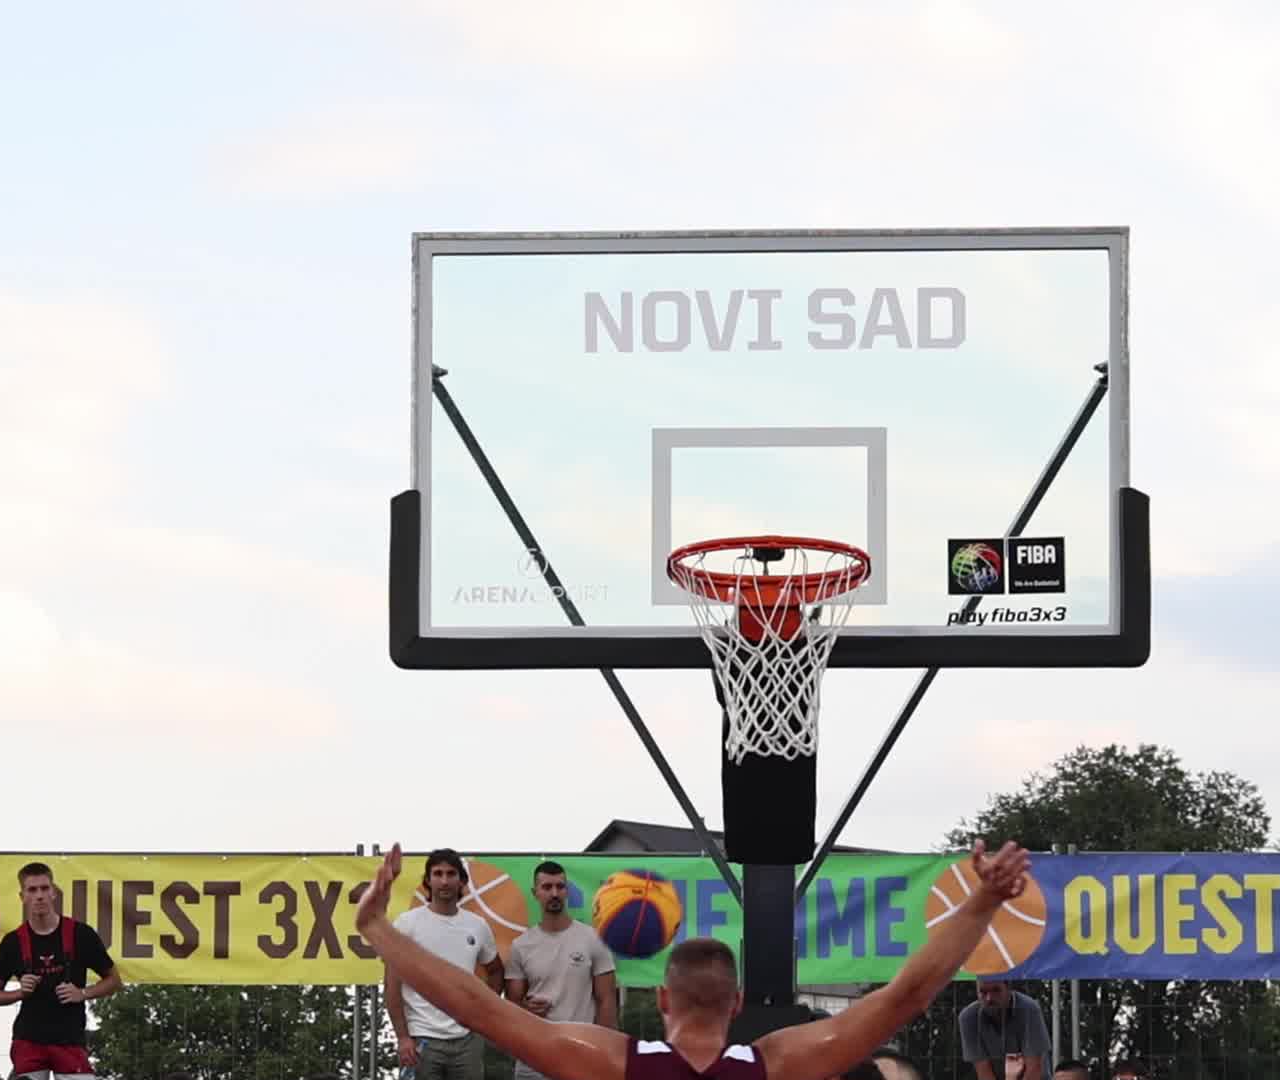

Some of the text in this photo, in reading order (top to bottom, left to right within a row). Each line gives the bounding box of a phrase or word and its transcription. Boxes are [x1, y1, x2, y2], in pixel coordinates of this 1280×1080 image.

[584, 287, 967, 353] NOVI SAD
[1017, 545, 1056, 564] FIBA
[946, 607, 1067, 627] play fiba3x3
[24, 880, 241, 960] UEST
